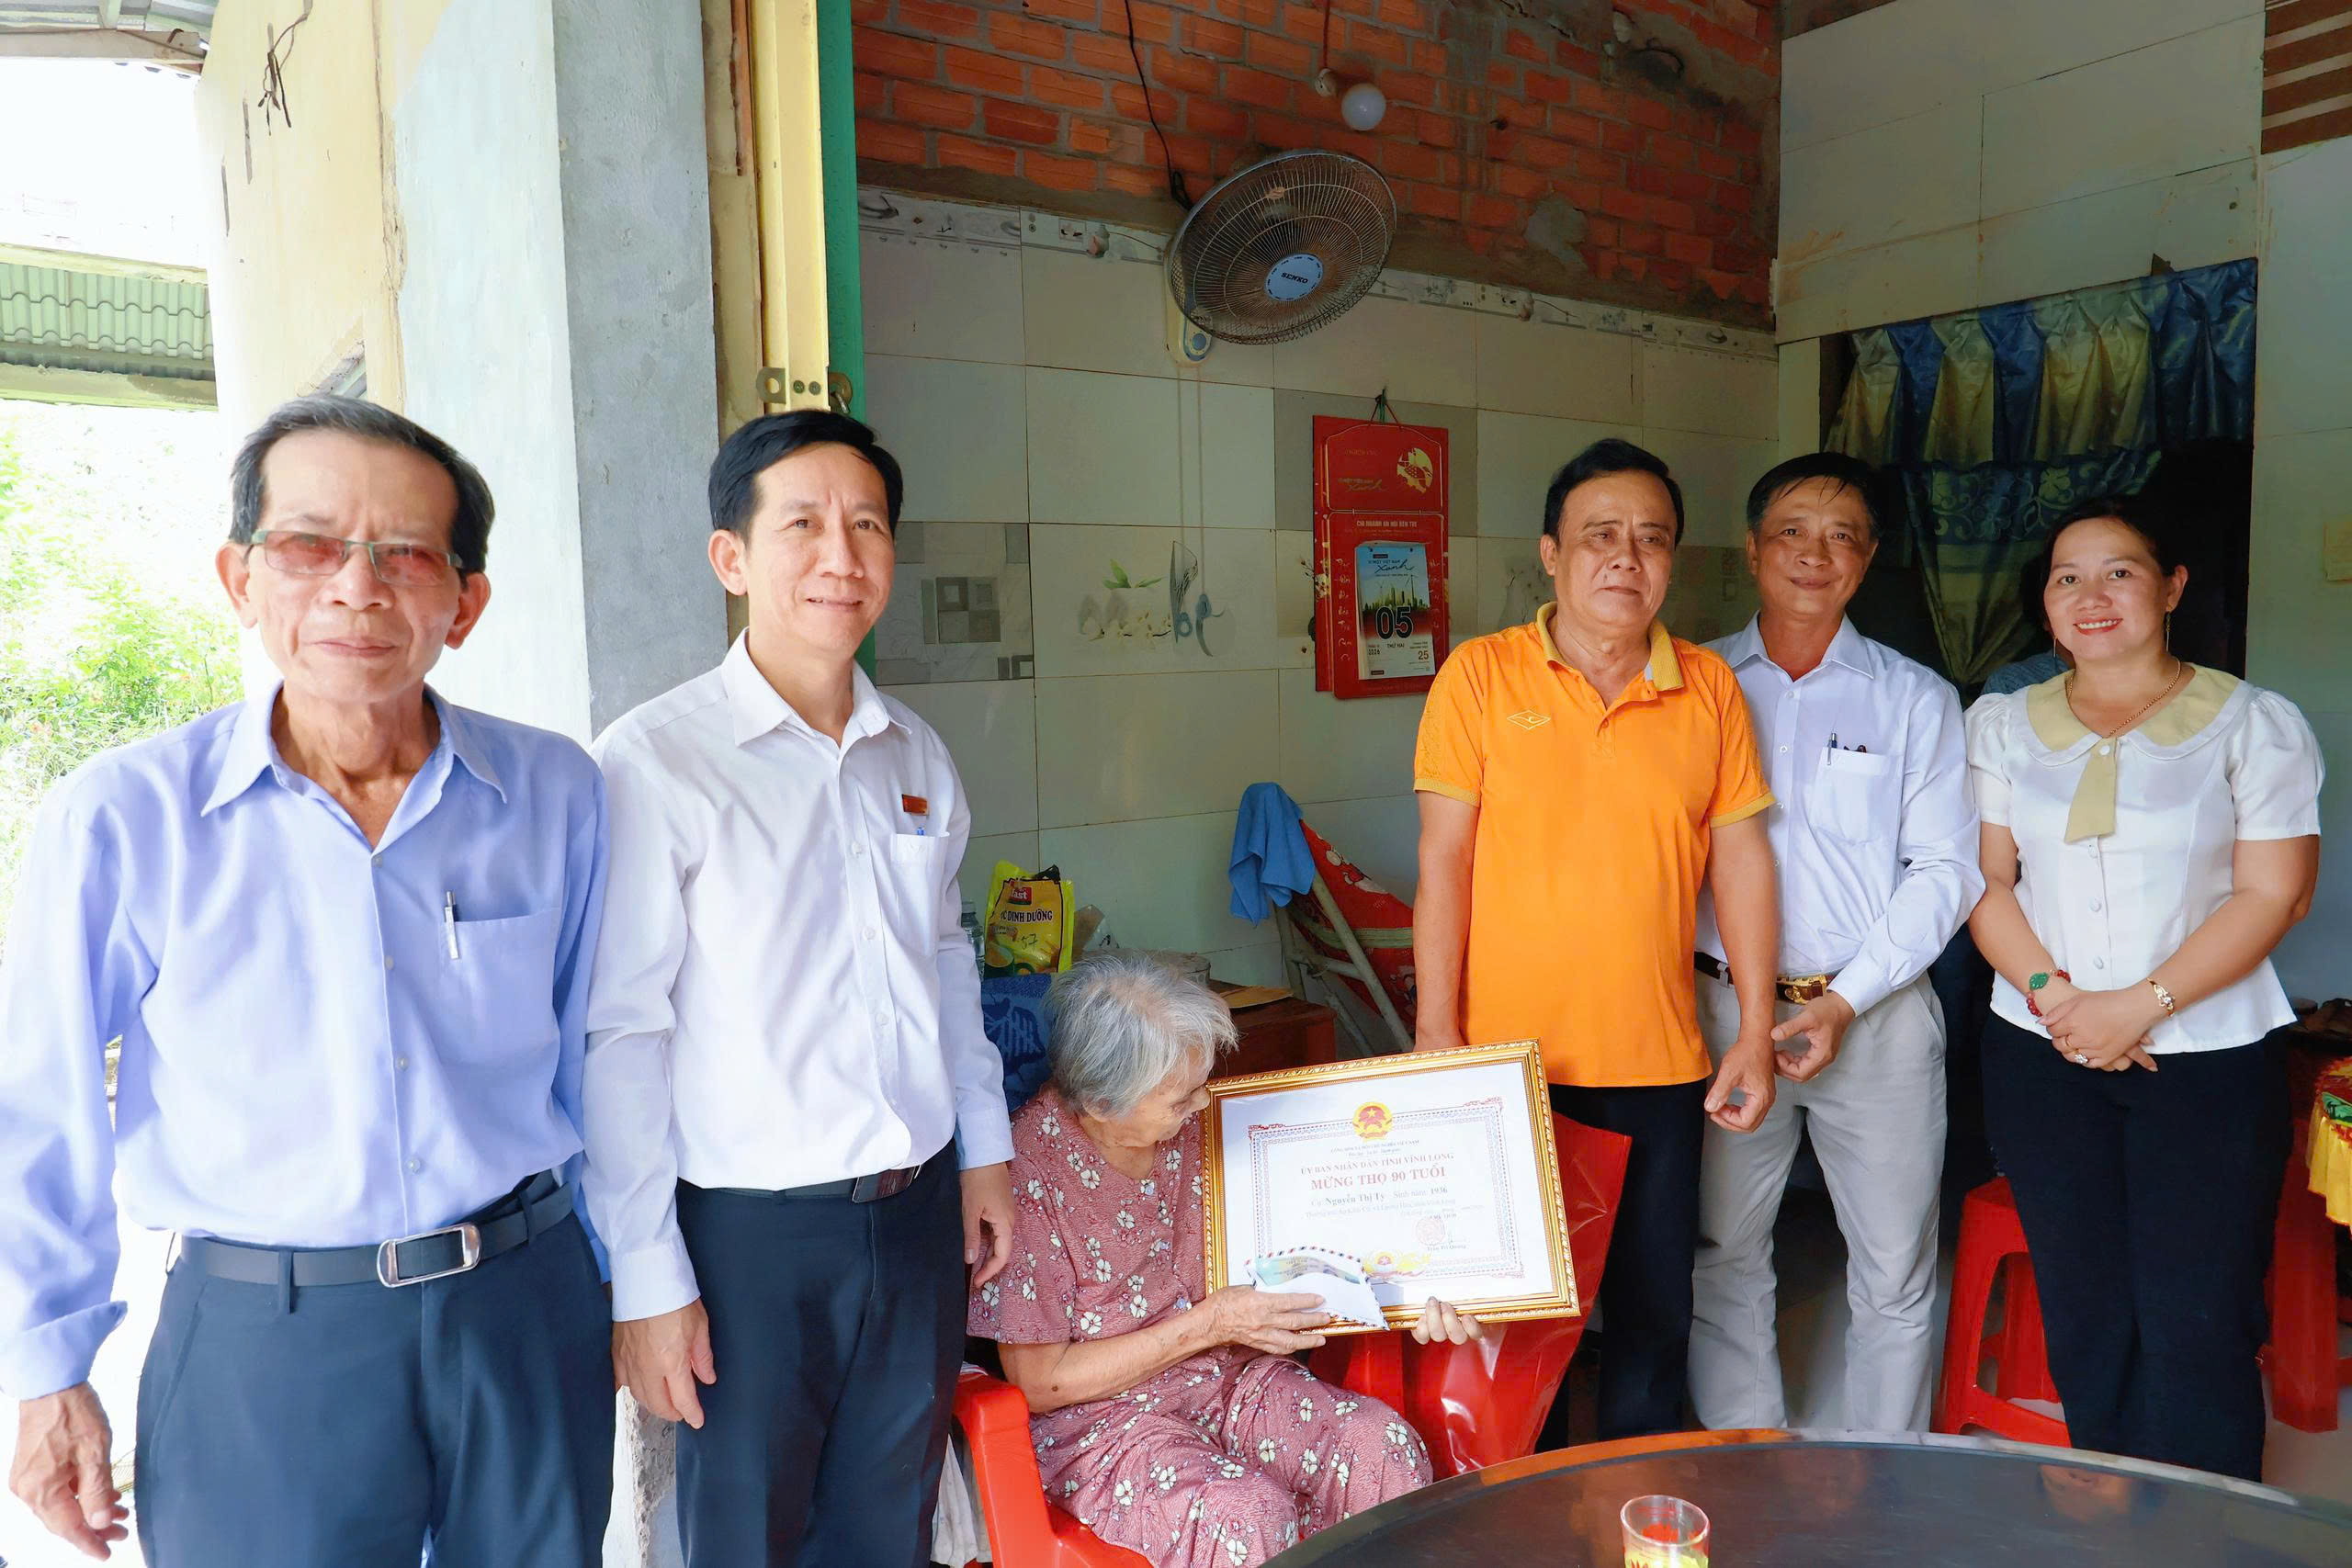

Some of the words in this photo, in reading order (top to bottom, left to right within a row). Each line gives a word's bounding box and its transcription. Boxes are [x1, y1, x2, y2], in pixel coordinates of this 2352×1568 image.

[1375, 605, 1414, 639] 05
[1418, 650, 1430, 660] 25
[1007, 910, 1025, 922] DINH
[1026, 908, 1053, 922] DƯỠNG
[1311, 1176, 1353, 1190] MỪNG
[1357, 1173, 1387, 1186] THỌ
[1391, 1171, 1406, 1182] 90
[1409, 1162, 1446, 1180] TUỔI
